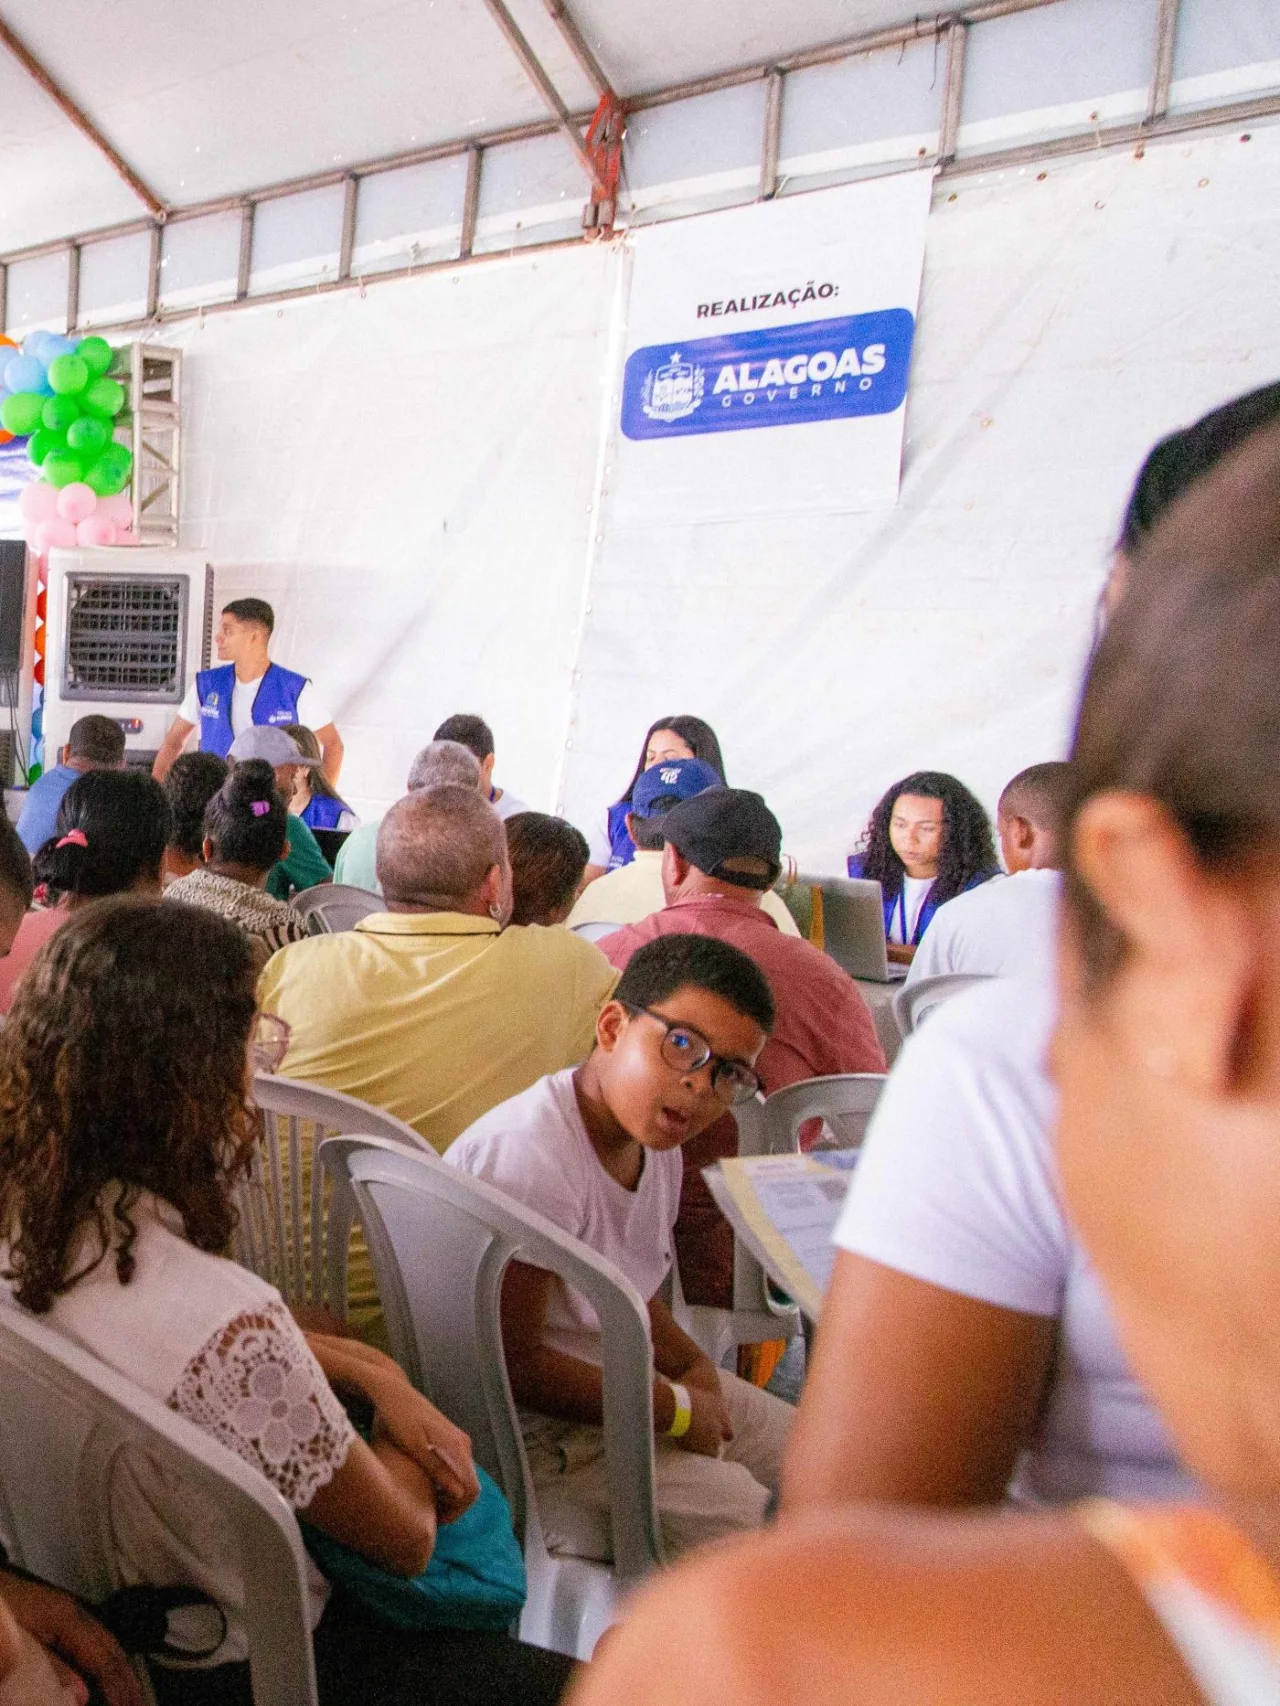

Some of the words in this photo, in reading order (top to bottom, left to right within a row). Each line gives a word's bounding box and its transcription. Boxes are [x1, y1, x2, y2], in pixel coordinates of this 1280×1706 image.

[696, 281, 840, 320] REALIZAÇÃO:
[712, 343, 886, 395] ALAGOAS
[721, 377, 873, 408] GOVERNO
